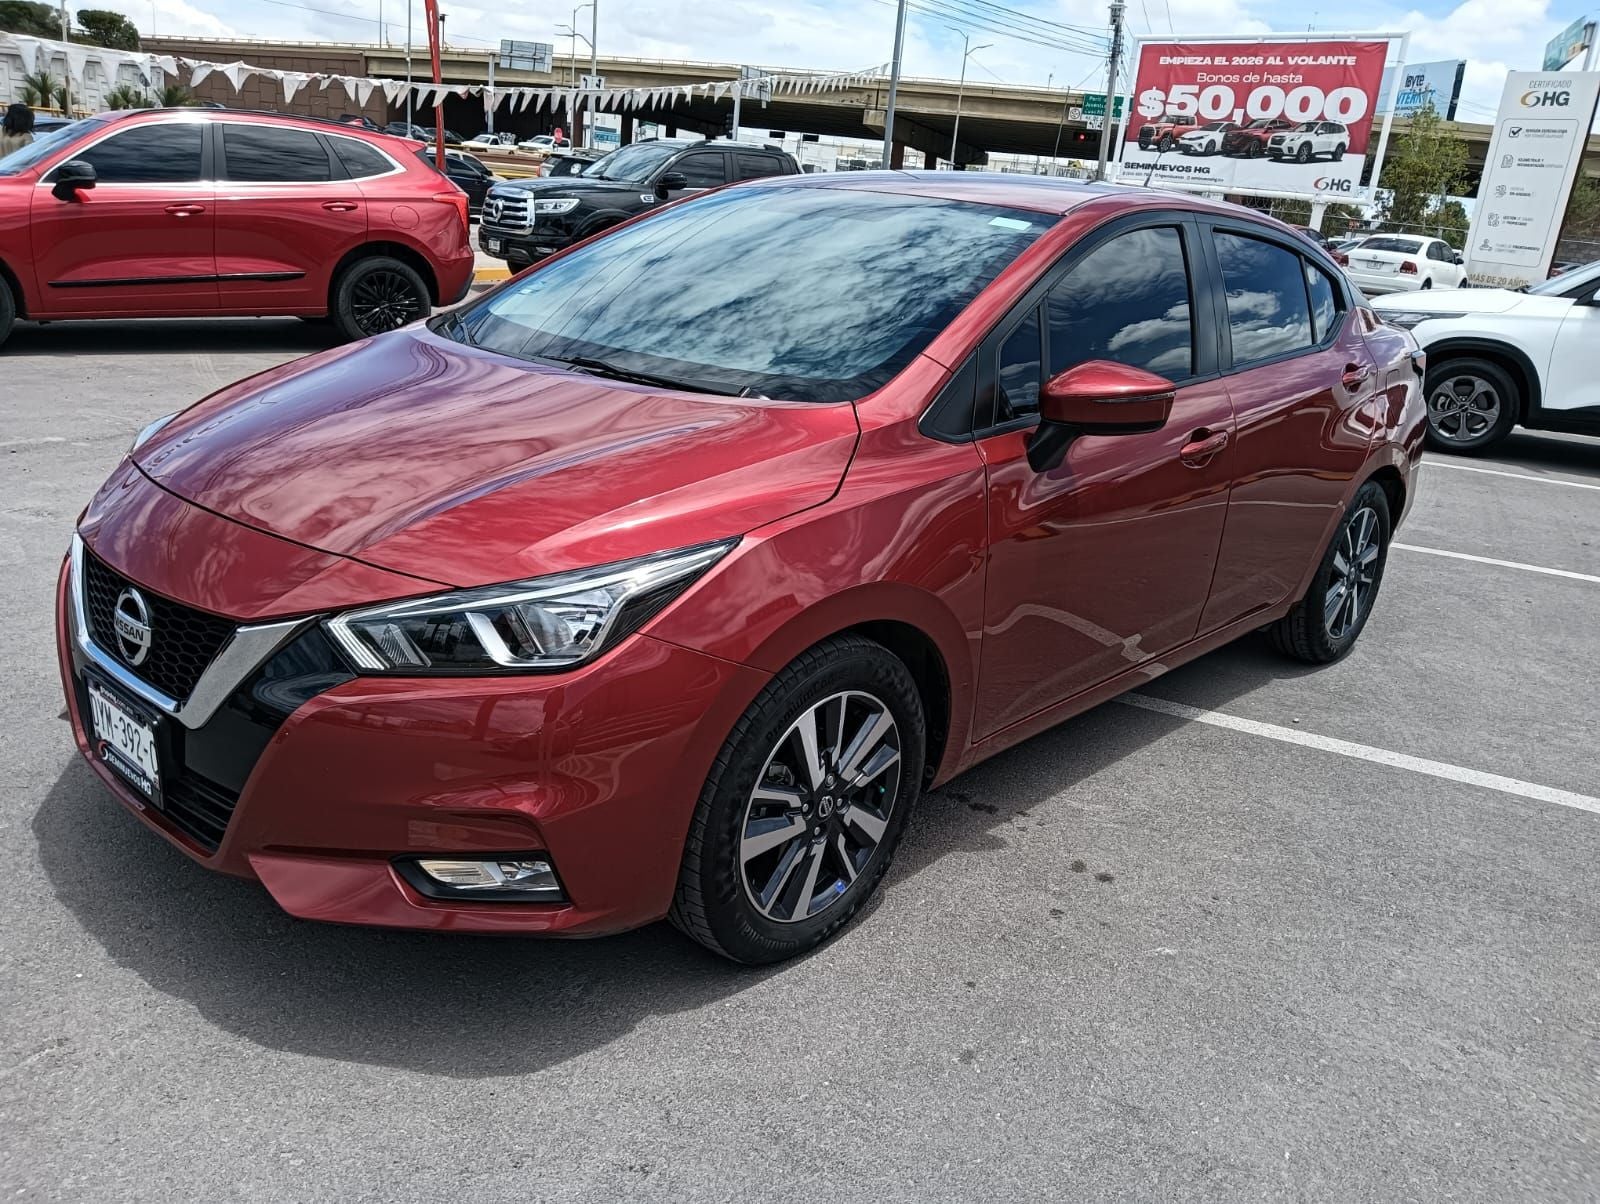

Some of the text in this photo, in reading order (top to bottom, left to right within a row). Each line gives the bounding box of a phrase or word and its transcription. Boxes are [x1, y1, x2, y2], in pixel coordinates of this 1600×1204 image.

[1159, 55, 1357, 65] EMPIEZA EL 2026 AL VOLANTE
[1197, 72, 1303, 84] Bonos de hasta
[1528, 80, 1573, 89] CERTIFICADO
[1137, 84, 1368, 125] $50,000
[1541, 91, 1570, 107] HG
[1124, 161, 1211, 175] SEMINUEVOS HG
[1328, 178, 1352, 192] HG
[1486, 275, 1497, 284] DE
[1498, 277, 1507, 285] 20
[1507, 276, 1529, 287] AÑOS
[115, 617, 145, 642] NISSAN
[141, 776, 152, 796] HG
